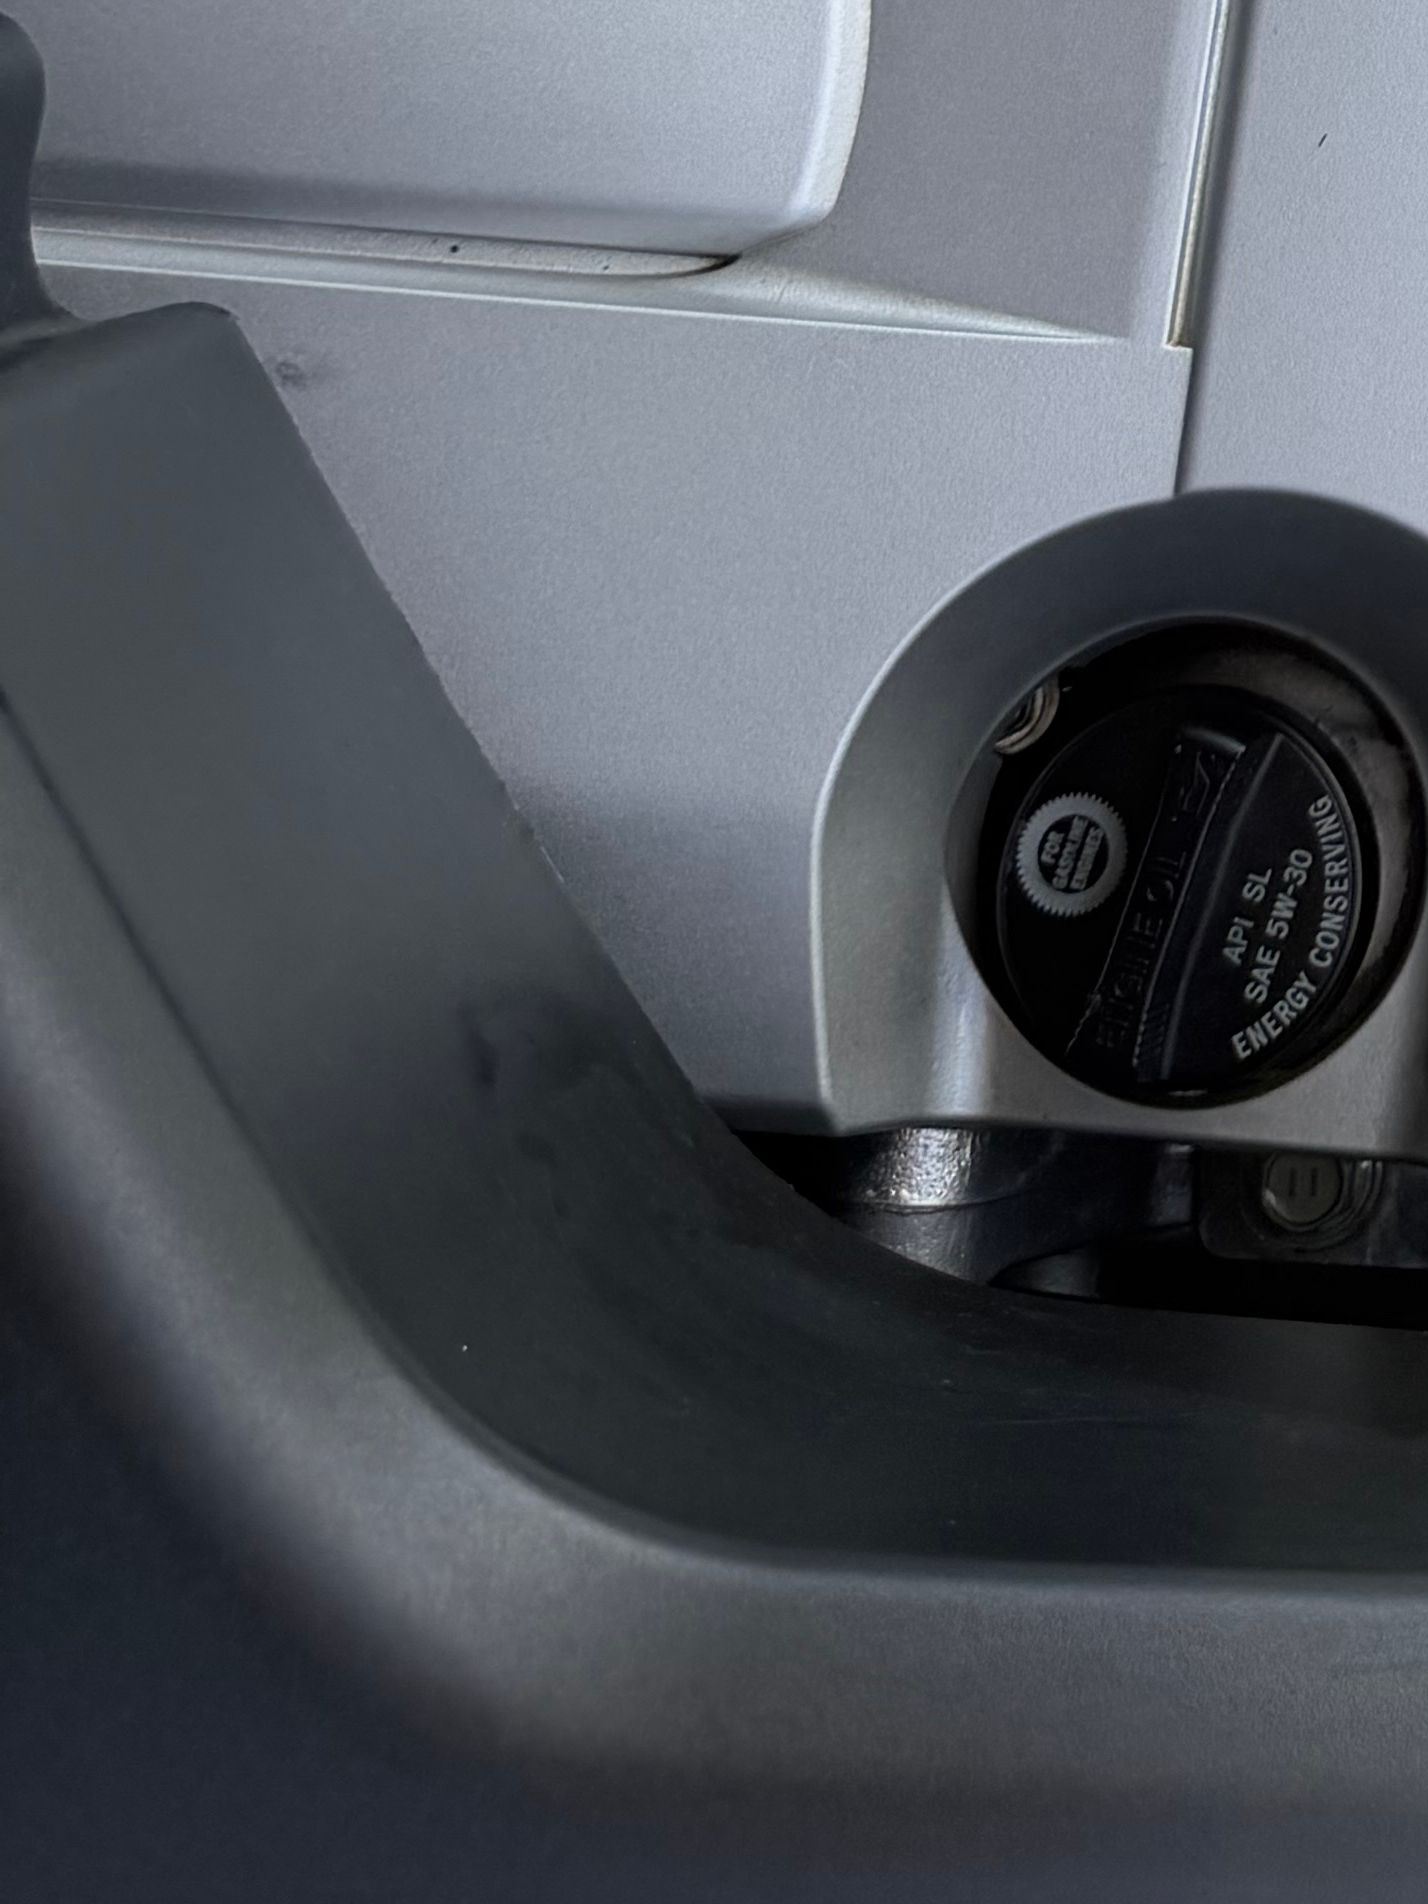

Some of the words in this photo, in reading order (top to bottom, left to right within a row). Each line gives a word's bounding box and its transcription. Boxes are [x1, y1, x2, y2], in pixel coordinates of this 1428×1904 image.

[1041, 831, 1065, 865] FOR
[1052, 816, 1088, 889] GASOLINE
[1070, 826, 1105, 889] ENGINES
[1097, 912, 1164, 1047] ENGINE
[1147, 851, 1188, 902] OIL
[1223, 916, 1254, 966] API
[1243, 868, 1272, 903] SL
[1231, 970, 1318, 1060] ENERGY
[1308, 794, 1349, 968] CONSERVING
[1244, 949, 1281, 1004] SAE
[1266, 848, 1313, 939] 5W-30
